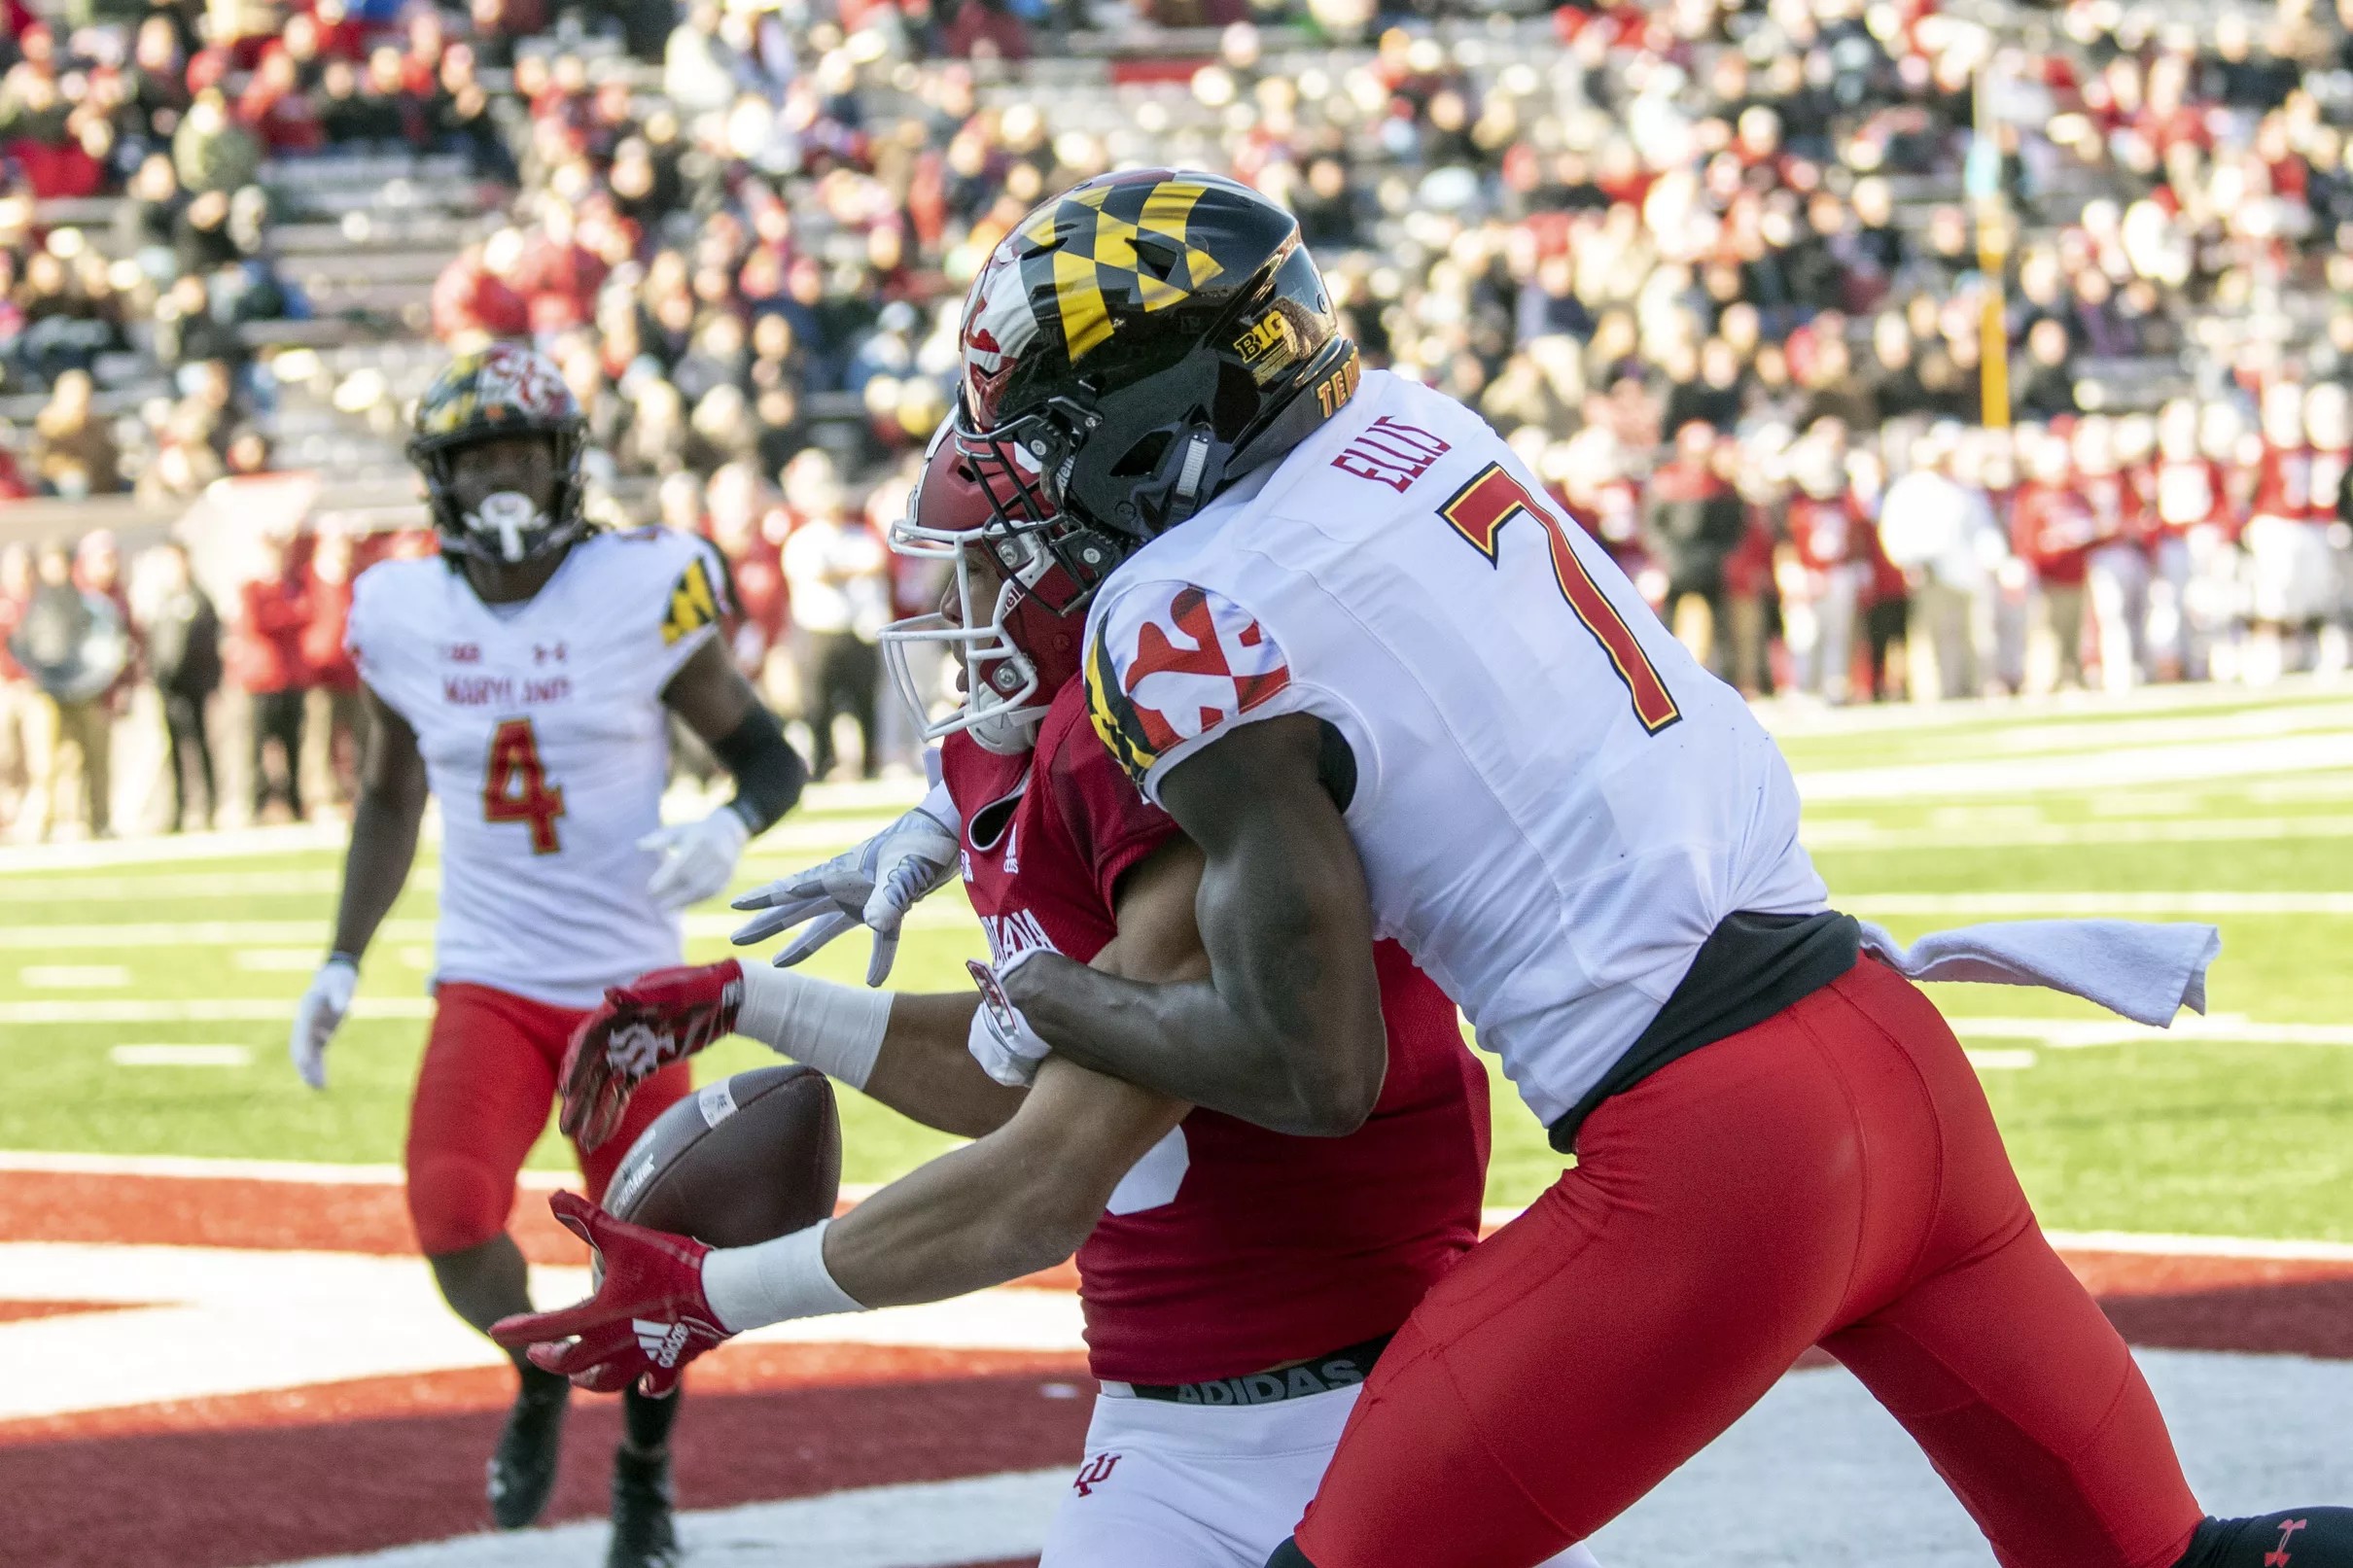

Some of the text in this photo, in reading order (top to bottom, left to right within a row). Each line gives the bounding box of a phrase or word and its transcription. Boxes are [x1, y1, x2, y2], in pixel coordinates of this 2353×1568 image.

[1330, 415, 1453, 494] ELLIS
[1434, 461, 1683, 738] 7
[480, 714, 567, 856] 4
[1177, 1359, 1364, 1406] ADIDAS
